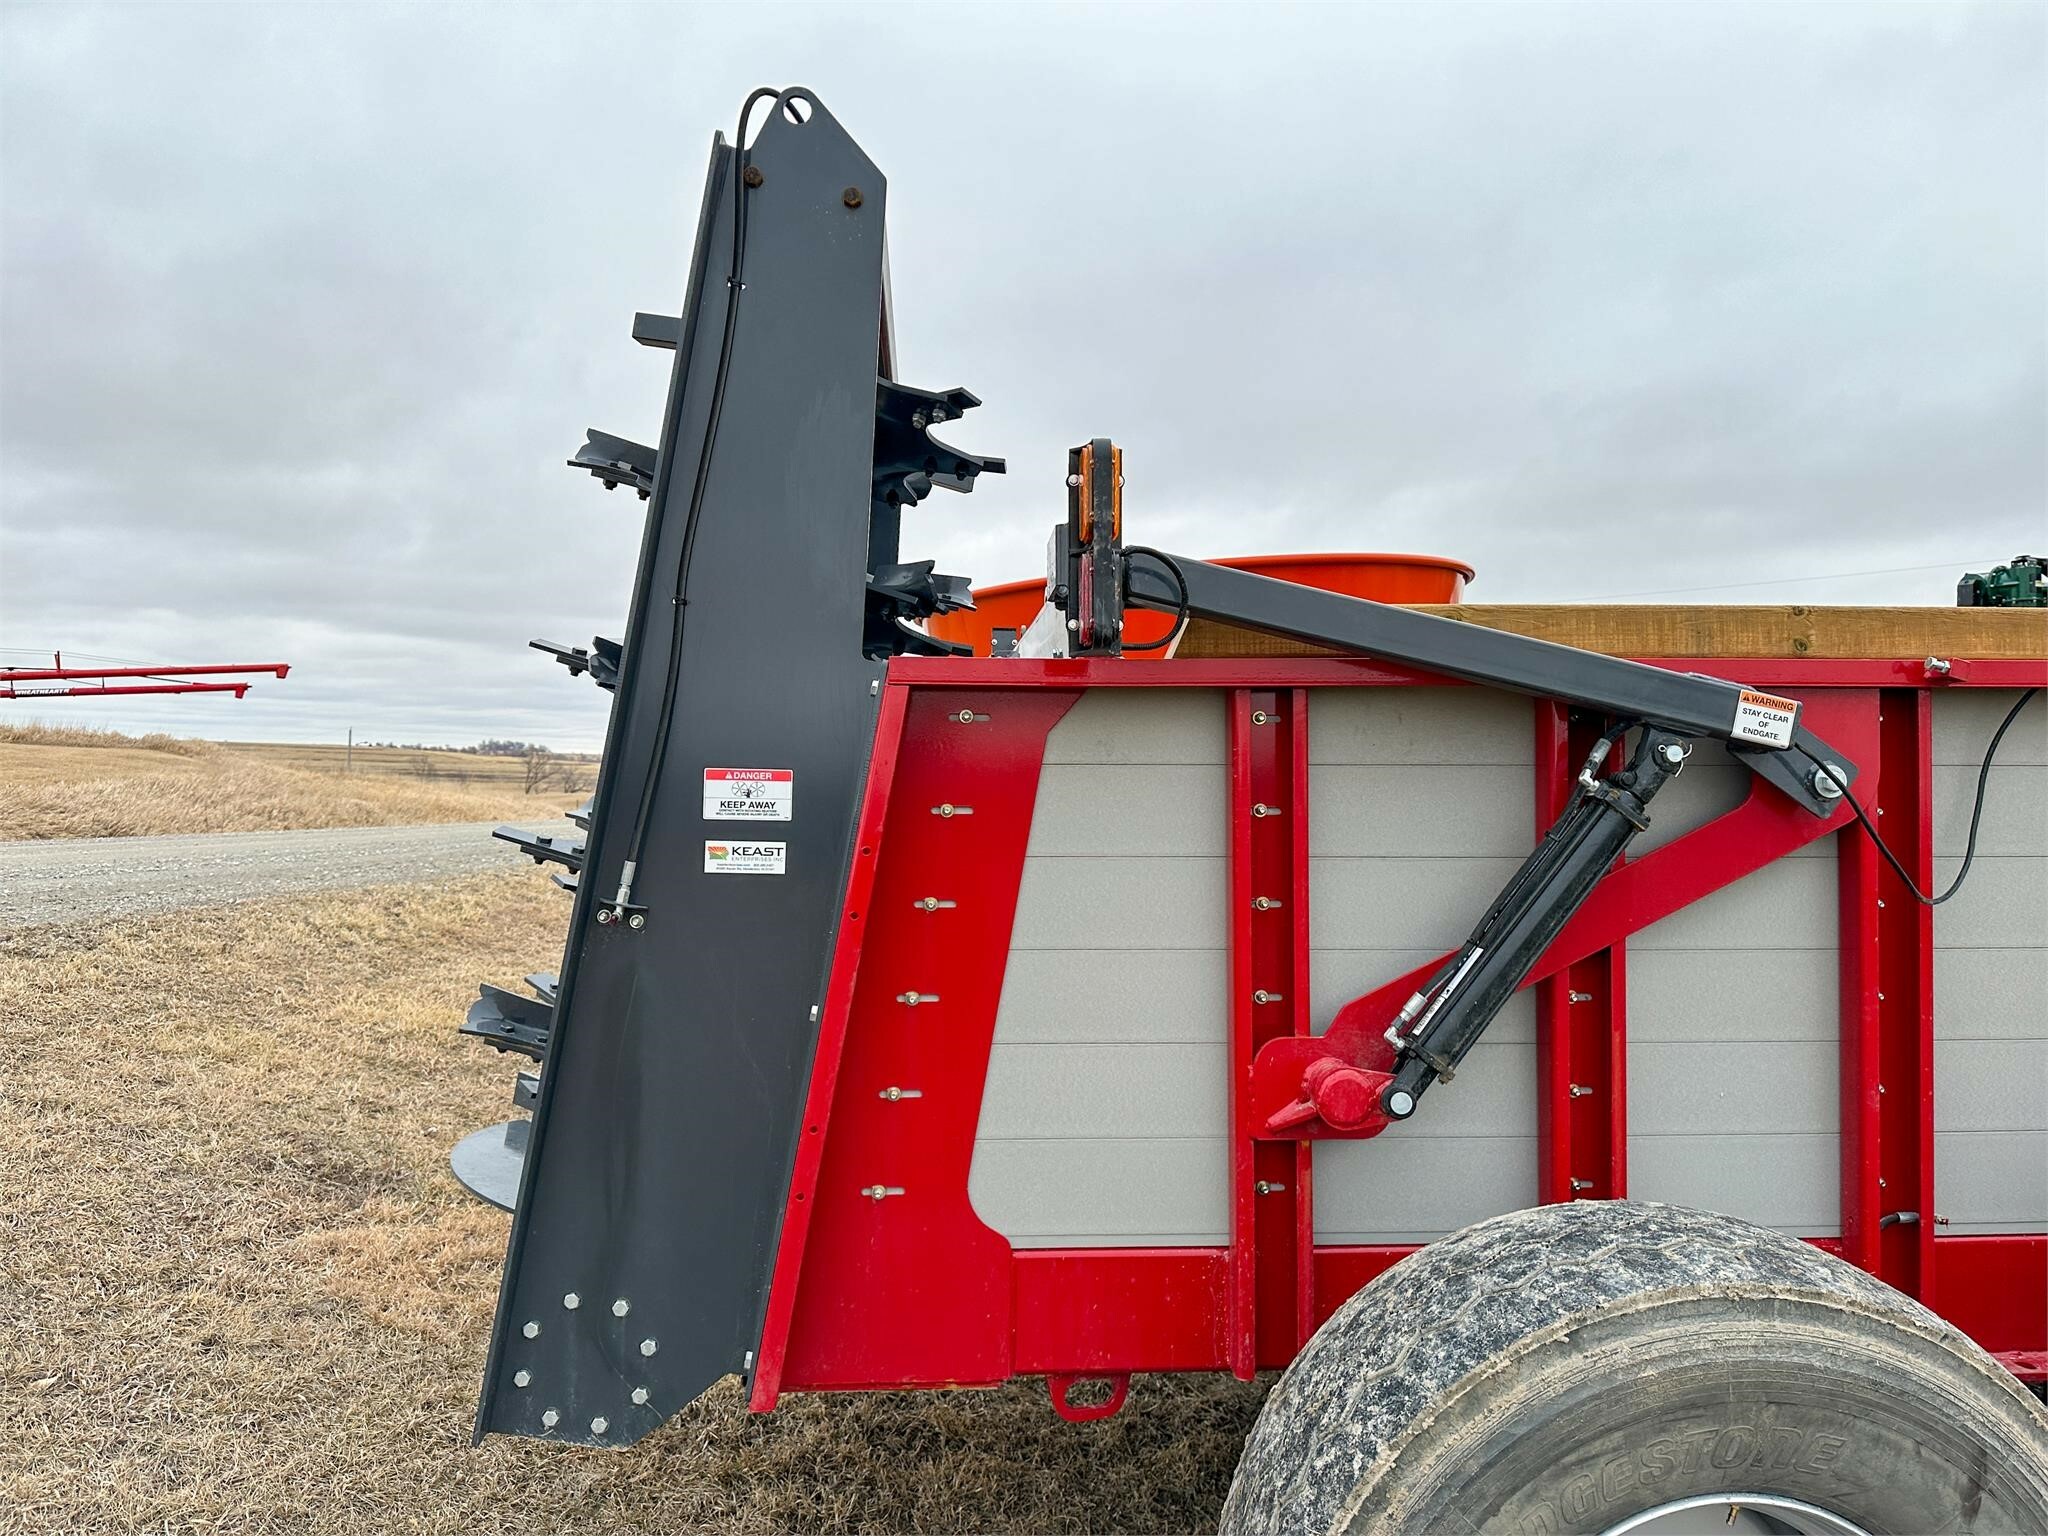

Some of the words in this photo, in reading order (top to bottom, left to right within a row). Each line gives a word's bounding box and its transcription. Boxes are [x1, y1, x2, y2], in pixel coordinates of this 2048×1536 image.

[1751, 695, 1794, 710] WARNING
[1742, 707, 1761, 717] STAY
[1763, 712, 1789, 723] CLEAR
[1758, 720, 1769, 728] OF
[733, 771, 773, 780] DANGER
[720, 801, 746, 809] KEEP
[748, 801, 776, 810] AWAY
[732, 846, 784, 857] KEAST
[1510, 1425, 1848, 1536] DGESTONE
